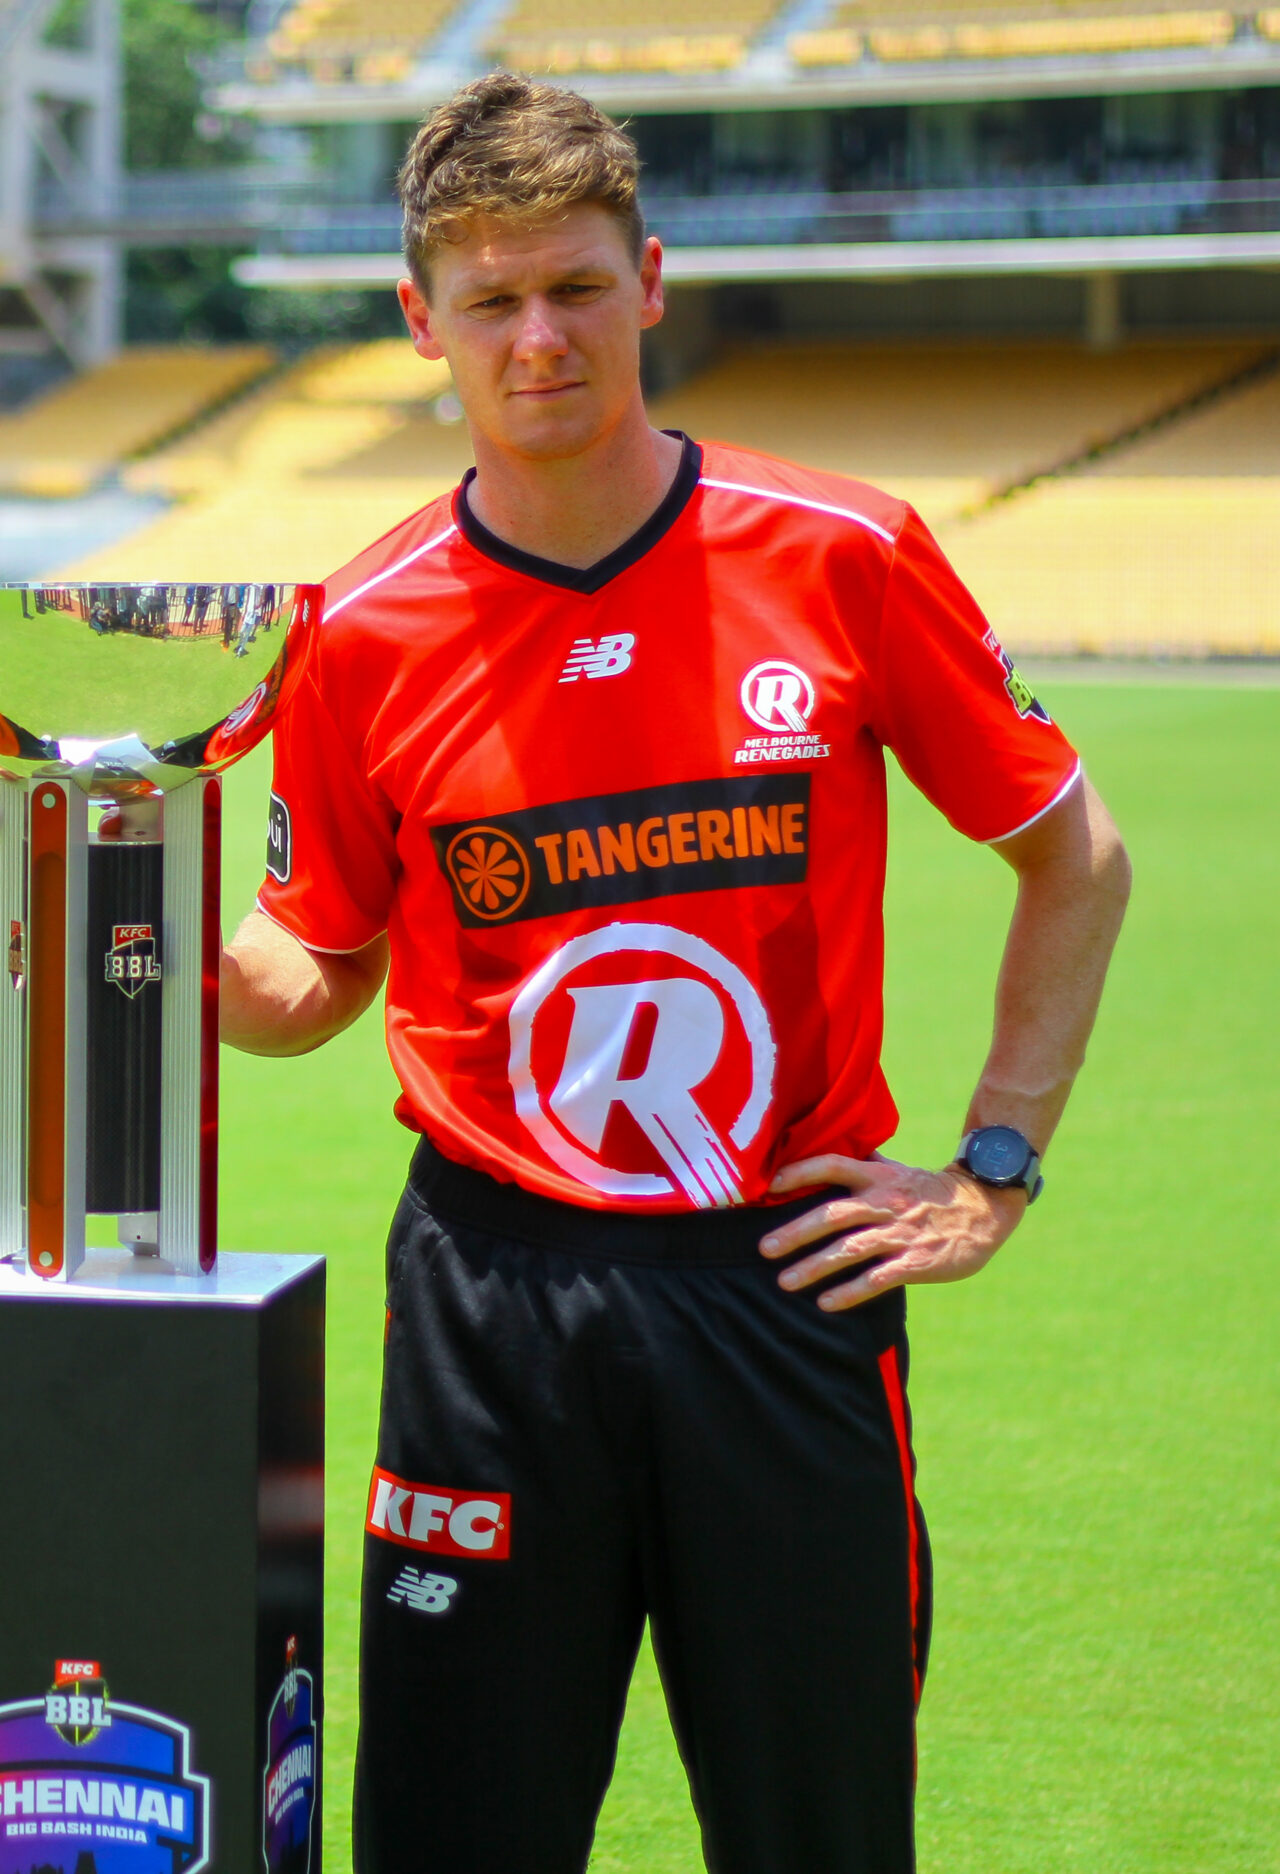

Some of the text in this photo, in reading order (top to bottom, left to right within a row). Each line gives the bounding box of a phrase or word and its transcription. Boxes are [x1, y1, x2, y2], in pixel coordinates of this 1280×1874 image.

[559, 633, 635, 683] NB
[734, 744, 831, 763] RENEGADES
[744, 734, 822, 749] MELBOURNE
[535, 803, 805, 886] TANGERINE
[120, 928, 147, 938] KFC
[371, 1478, 502, 1551] KFC
[387, 1565, 458, 1613] NB
[61, 1662, 94, 1676] KFC
[45, 1695, 112, 1727] BBL
[268, 1744, 312, 1818] CHENNAI
[6, 1821, 147, 1843] BIG BASH INDIA
